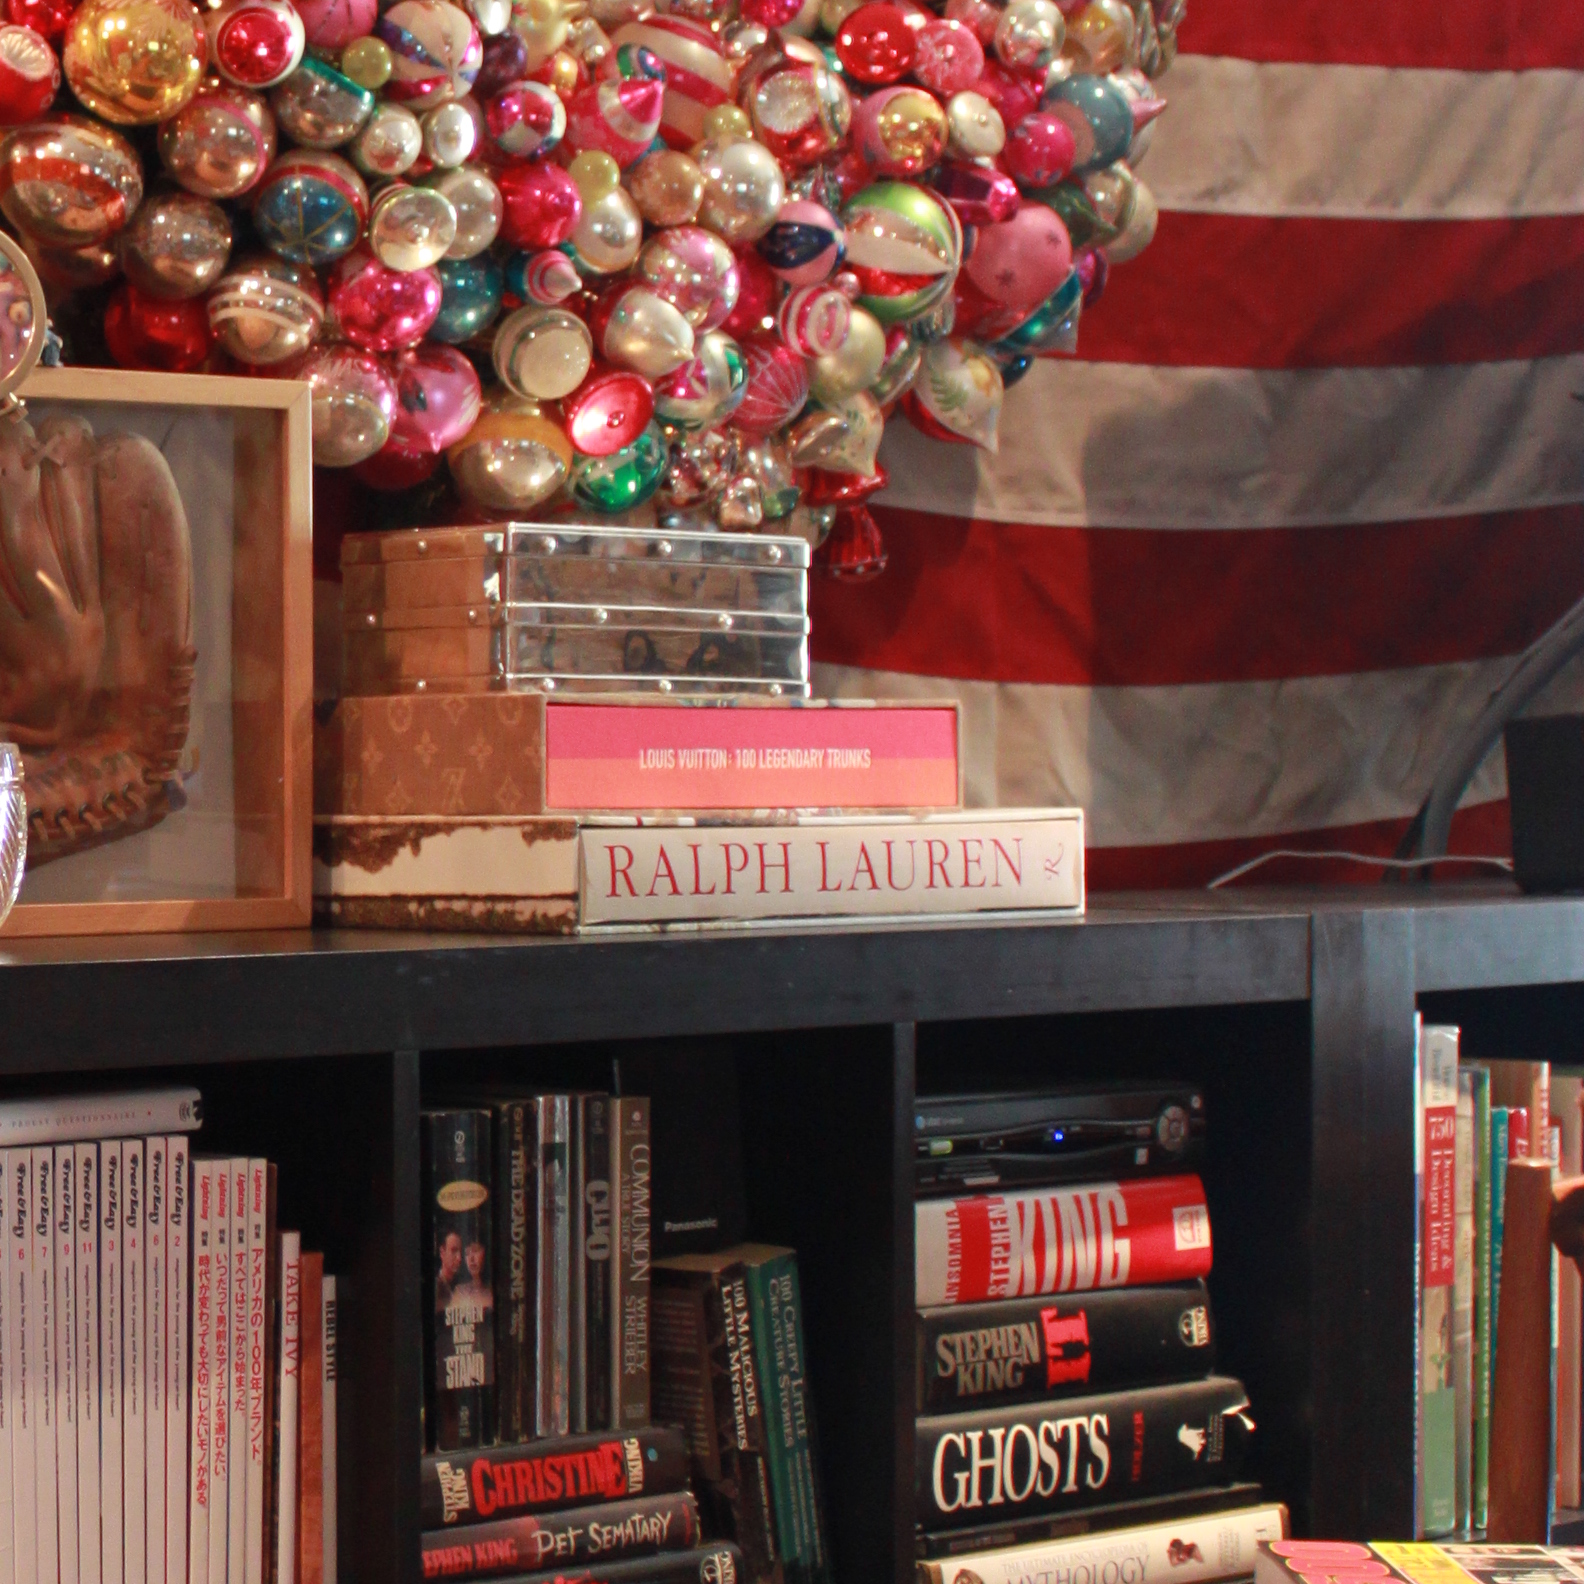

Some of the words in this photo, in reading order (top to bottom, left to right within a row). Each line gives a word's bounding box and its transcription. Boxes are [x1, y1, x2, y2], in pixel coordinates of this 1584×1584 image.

[639, 749, 675, 769] LOUIS
[678, 749, 733, 769] VUITTON:
[735, 749, 757, 768] 100
[759, 749, 824, 768] LEGENDARY
[827, 749, 871, 768] TRUNKS
[604, 843, 795, 898] RALPH
[816, 837, 1023, 893] LAUREN
[630, 1144, 649, 1282] COMMUNION
[665, 1218, 718, 1232] Panasonic
[1016, 1190, 1130, 1295] KING
[945, 1209, 962, 1303] INSOMNIA
[988, 1204, 1010, 1296] STEPHEN
[285, 1262, 300, 1326] TAKE
[326, 1301, 335, 1339] REBEL
[249, 1248, 264, 1465] アメリカの100年ブランド。
[285, 1338, 298, 1377] IVY
[937, 1322, 1041, 1377] STEPHEN
[957, 1358, 1023, 1396] KING
[471, 1442, 627, 1516] CHRISTINE
[933, 1414, 1110, 1513] GHOSTS
[474, 1539, 515, 1568] KING
[588, 1512, 671, 1554] SEMATARY
